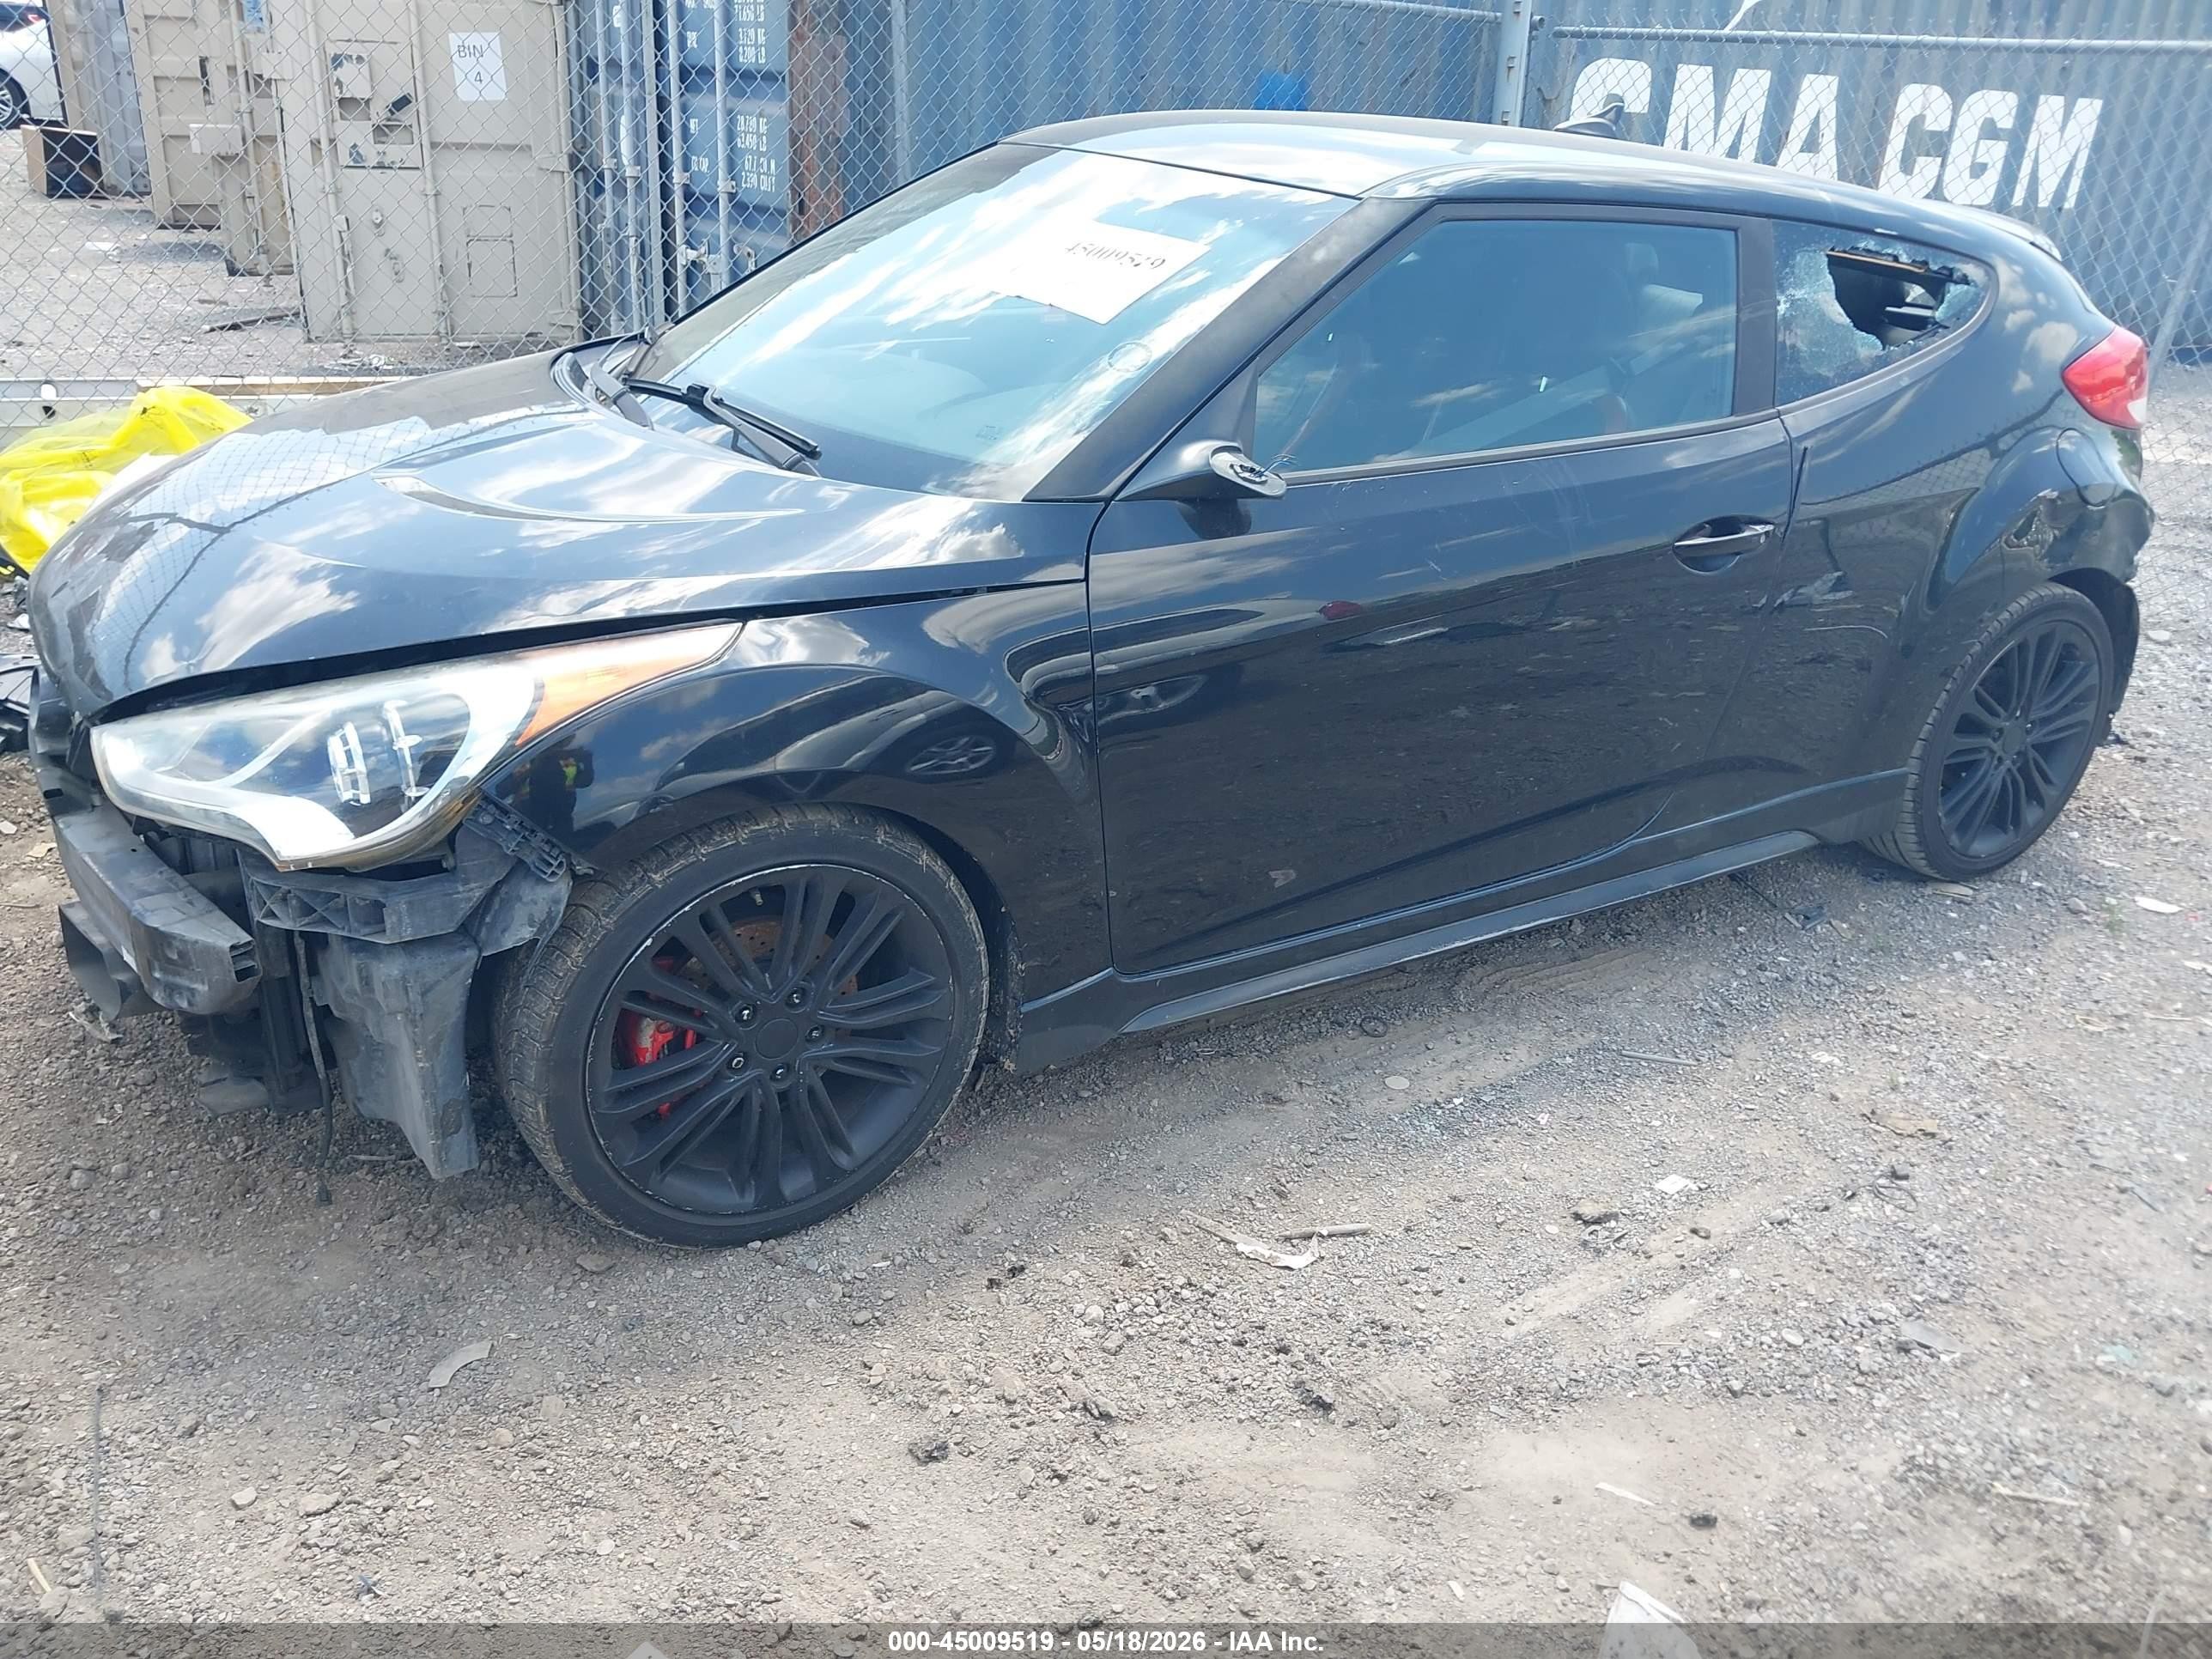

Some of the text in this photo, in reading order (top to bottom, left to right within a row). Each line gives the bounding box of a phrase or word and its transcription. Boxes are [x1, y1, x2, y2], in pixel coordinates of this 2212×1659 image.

[757, 4, 764, 21] LB
[458, 44, 483, 58] BIN
[757, 46, 765, 64] LB
[474, 70, 483, 84] 4
[737, 132, 767, 151] 63.450 LB
[1878, 83, 2102, 209] CGM
